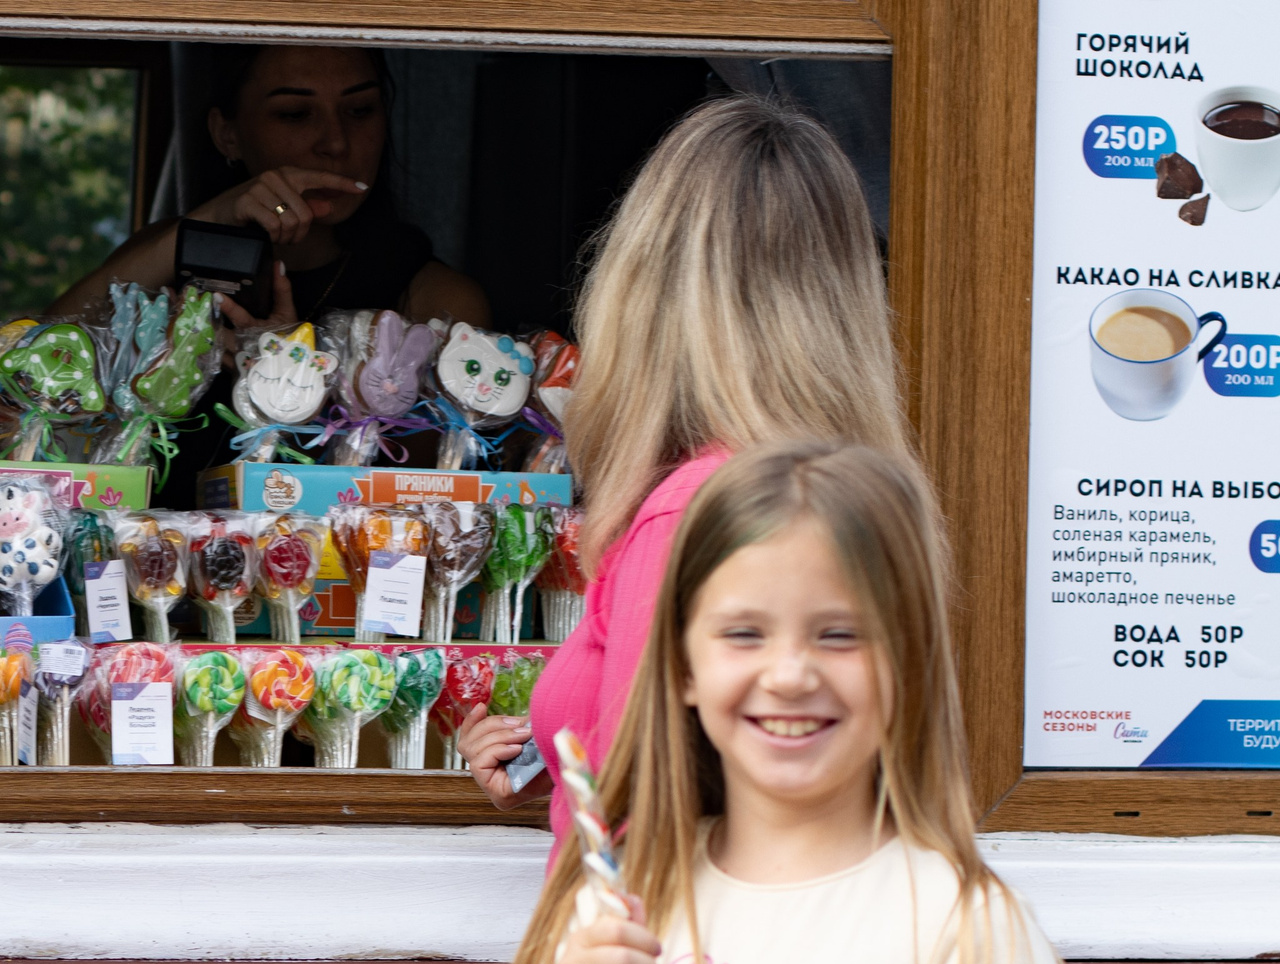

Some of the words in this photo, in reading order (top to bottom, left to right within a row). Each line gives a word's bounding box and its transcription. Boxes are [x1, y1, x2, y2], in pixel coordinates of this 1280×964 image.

[1076, 31, 1190, 55] ГОРЯЧИЙ
[1076, 58, 1204, 82] ШОКОЛАД
[1093, 125, 1168, 151] 250Р
[1104, 155, 1131, 167] 200
[1056, 266, 1140, 286] КАКАО
[1149, 269, 1181, 287] НА
[1224, 374, 1251, 386] 200
[394, 474, 455, 493] ПРЯНИКИ
[1077, 478, 1163, 498] СИРОП
[1172, 481, 1204, 499] НА
[1053, 505, 1123, 523] Ваниль,
[1129, 509, 1196, 524] корица,
[1052, 528, 1122, 542] соленая
[1129, 529, 1217, 545] карамель,
[1051, 547, 1144, 564] имбирный
[1150, 551, 1217, 567] пряник,
[1051, 570, 1137, 585] амаретто,
[1051, 590, 1159, 607] шоколадное
[1164, 592, 1236, 606] печенье
[1114, 624, 1181, 644] ВОДА
[1200, 625, 1244, 643] 50Р
[1113, 650, 1165, 668] СОК
[1184, 650, 1228, 668] 50Р
[1043, 710, 1132, 720] МОСКОВСКИЕ
[1042, 722, 1097, 732] СЕЗОНЫ
